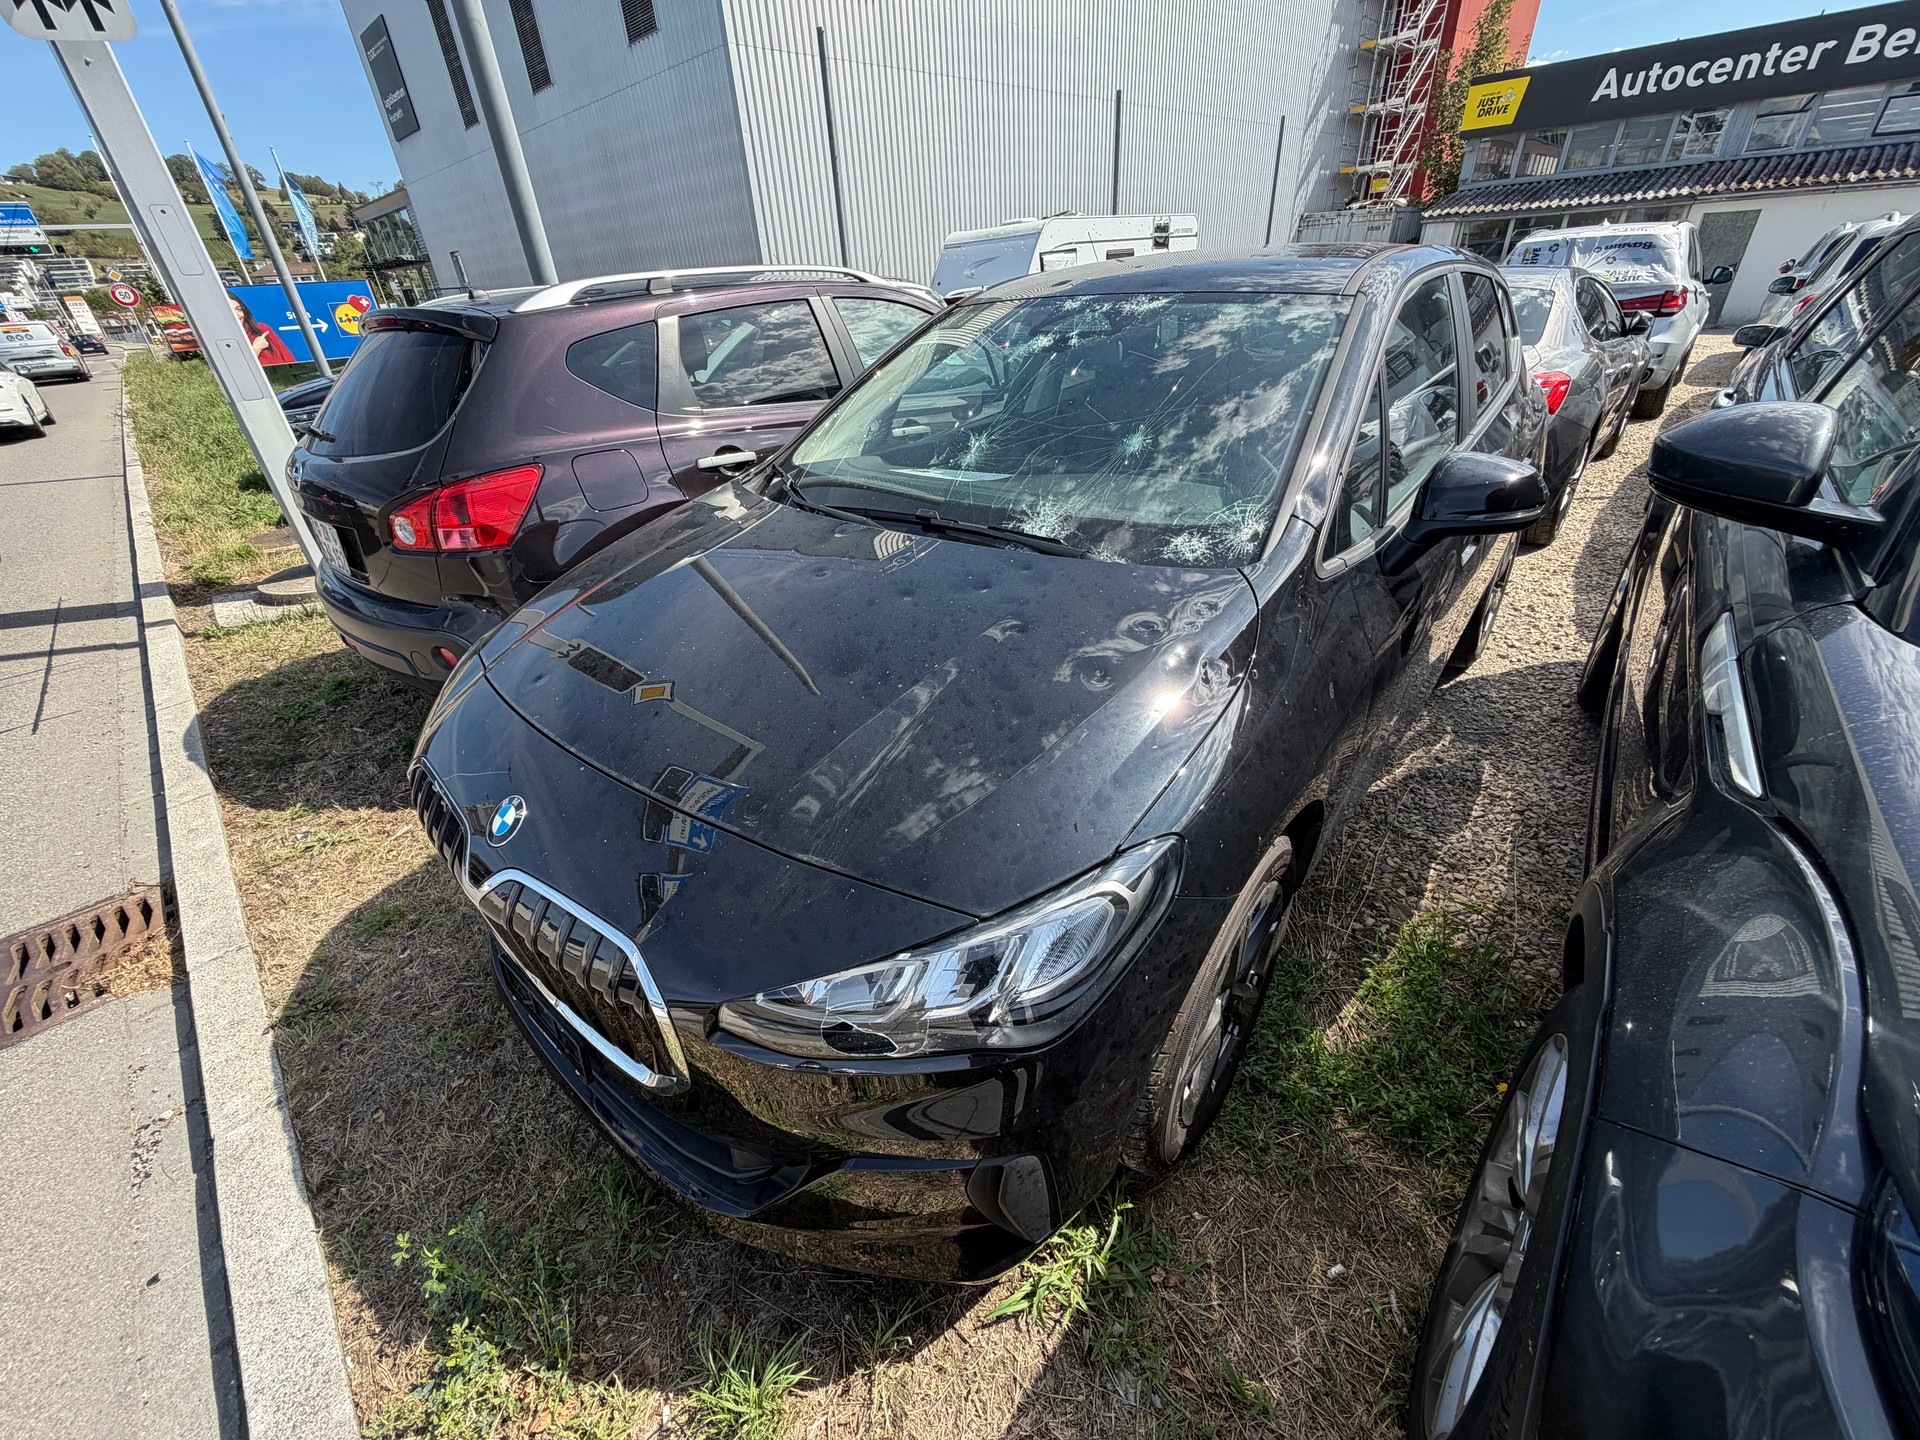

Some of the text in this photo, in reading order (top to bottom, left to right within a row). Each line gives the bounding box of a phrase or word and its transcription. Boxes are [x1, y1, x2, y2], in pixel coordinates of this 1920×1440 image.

[1591, 23, 1920, 102] Autocenter Be
[1476, 95, 1503, 108] JUST
[1477, 104, 1511, 118] DRIVE
[1604, 241, 1655, 250] Barum
[1529, 247, 1542, 265] RIVE
[1613, 275, 1641, 283] JUST
[117, 291, 131, 300] 50
